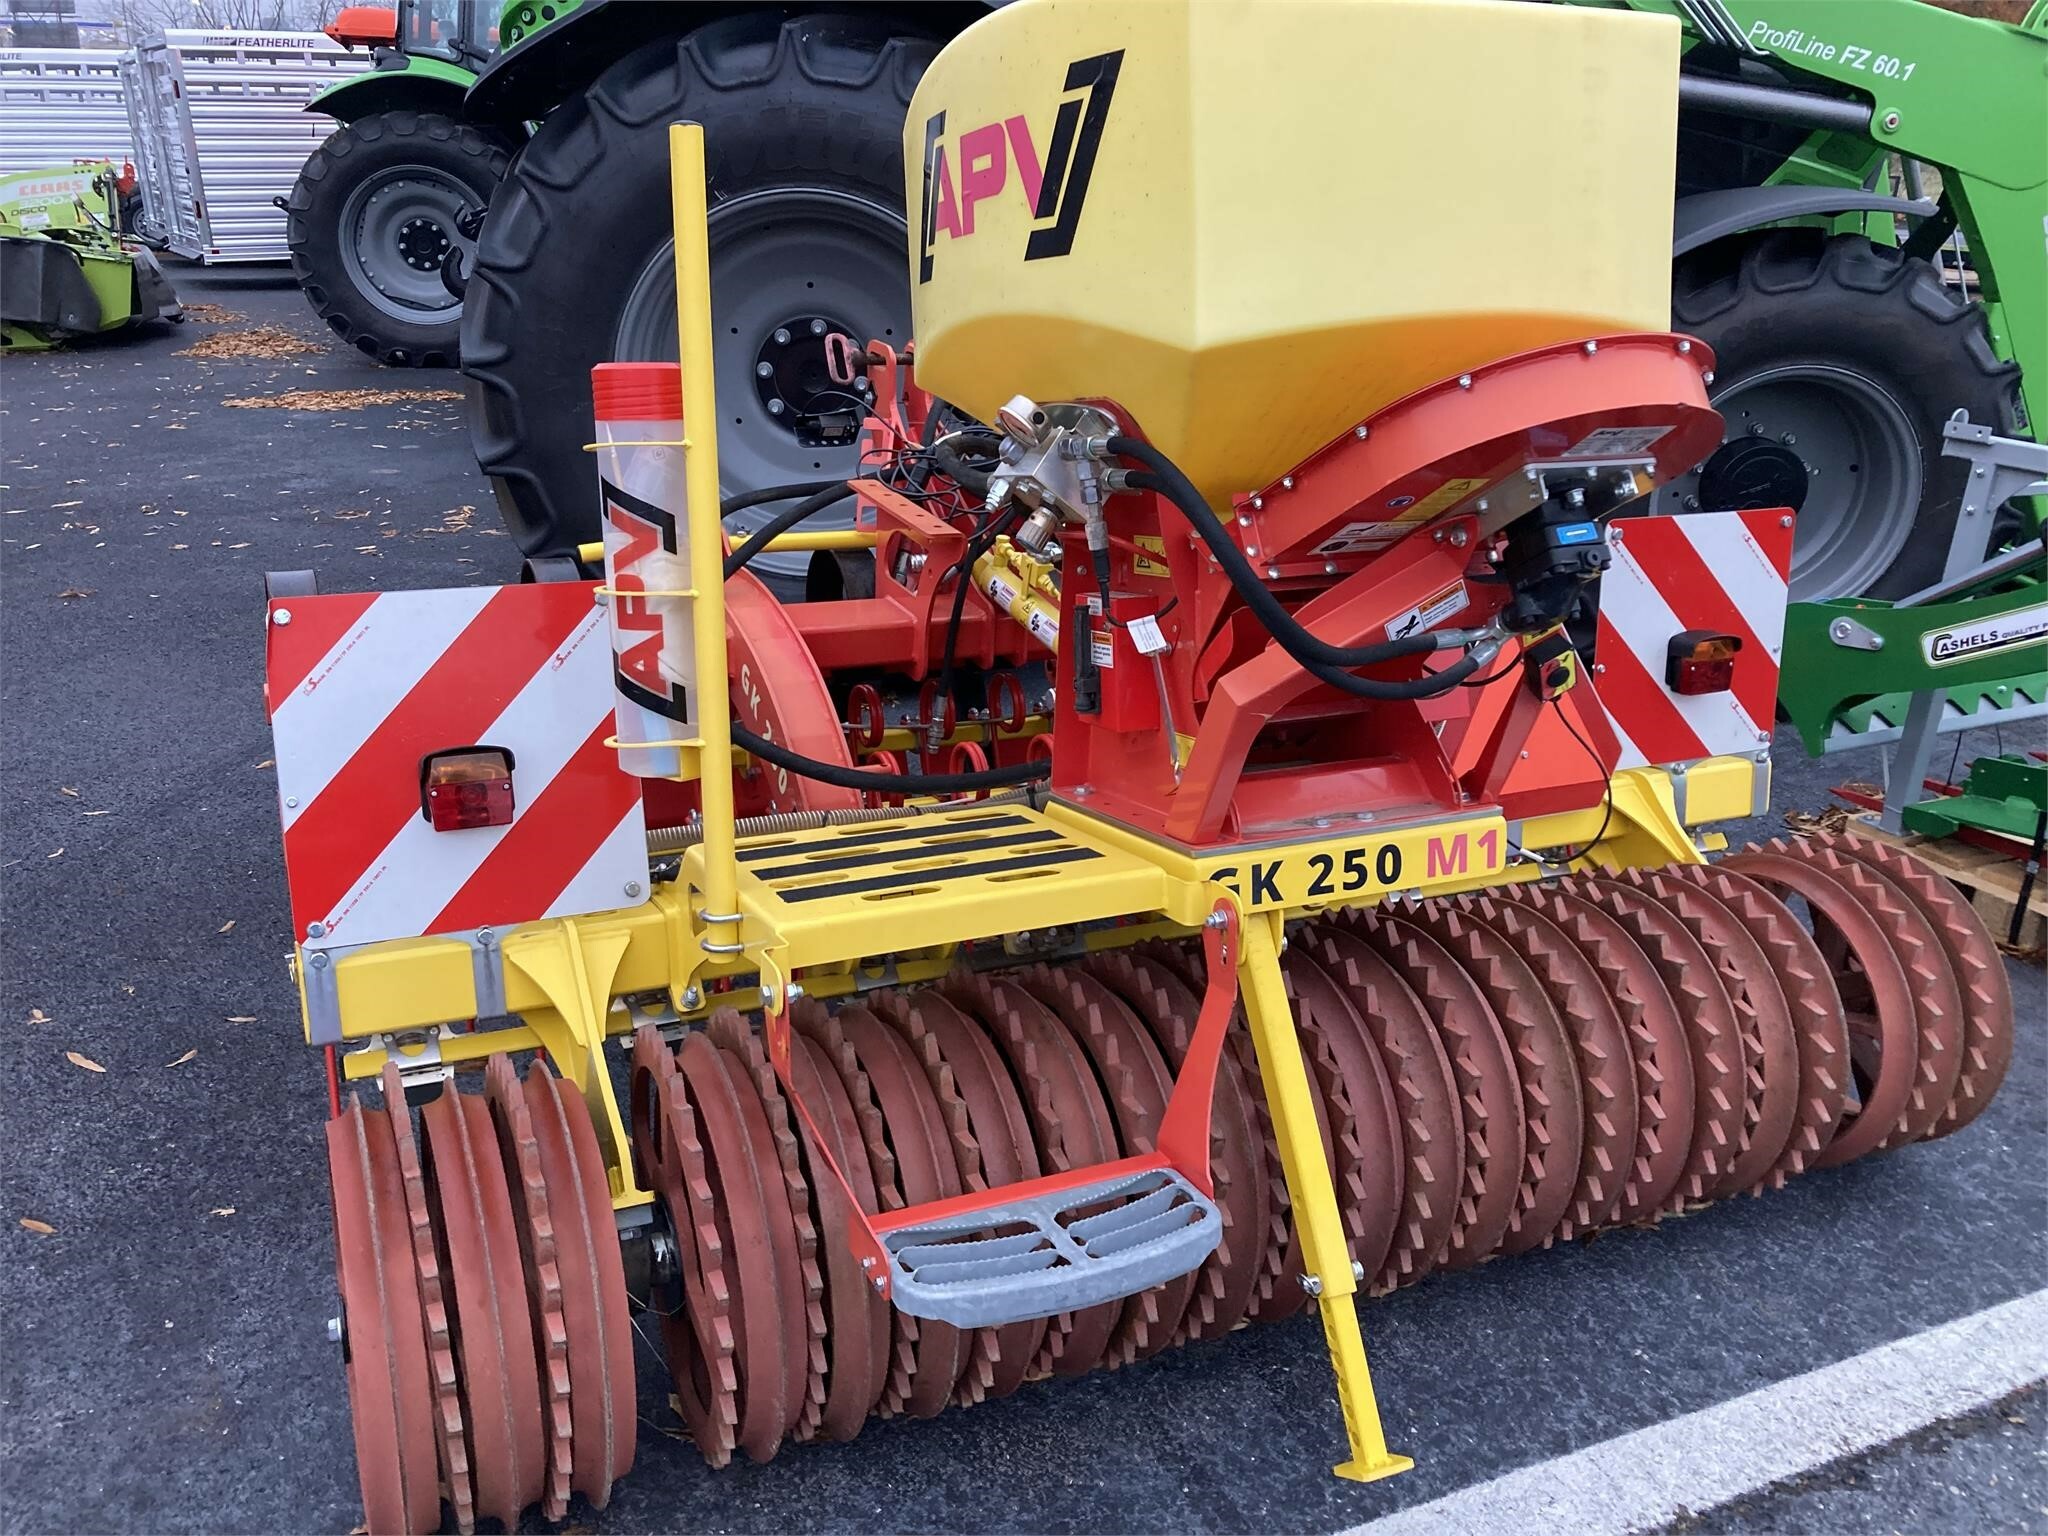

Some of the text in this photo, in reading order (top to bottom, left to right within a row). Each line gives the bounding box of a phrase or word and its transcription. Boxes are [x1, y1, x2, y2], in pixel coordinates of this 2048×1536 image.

[237, 37, 315, 49] FEATHERLITE
[1748, 20, 1917, 82] ProfiLine FZ 60.1
[0, 52, 22, 60] LITE
[18, 179, 85, 196] CLAAS
[10, 205, 48, 217] DISCO
[607, 502, 669, 697] APV
[2001, 624, 2040, 639] QUALITY
[741, 663, 788, 795] GK 20
[1306, 844, 1403, 897] 250
[1426, 828, 1498, 878] M1
